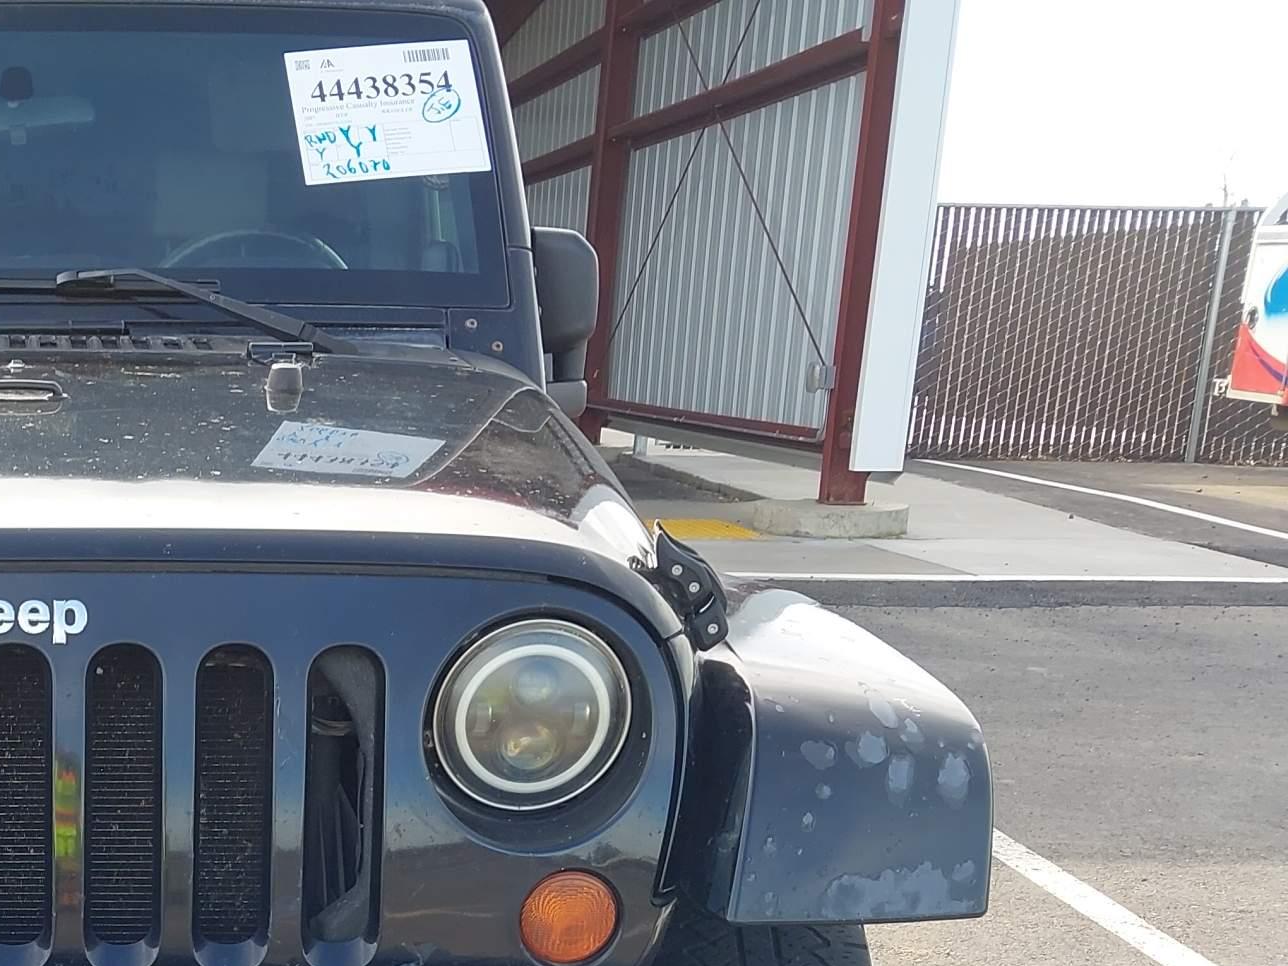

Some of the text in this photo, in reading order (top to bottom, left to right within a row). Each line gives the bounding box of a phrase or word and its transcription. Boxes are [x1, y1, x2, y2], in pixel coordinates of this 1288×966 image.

[311, 70, 453, 102] 44438354
[346, 100, 379, 110] Casualty
[380, 98, 415, 107] Insurance
